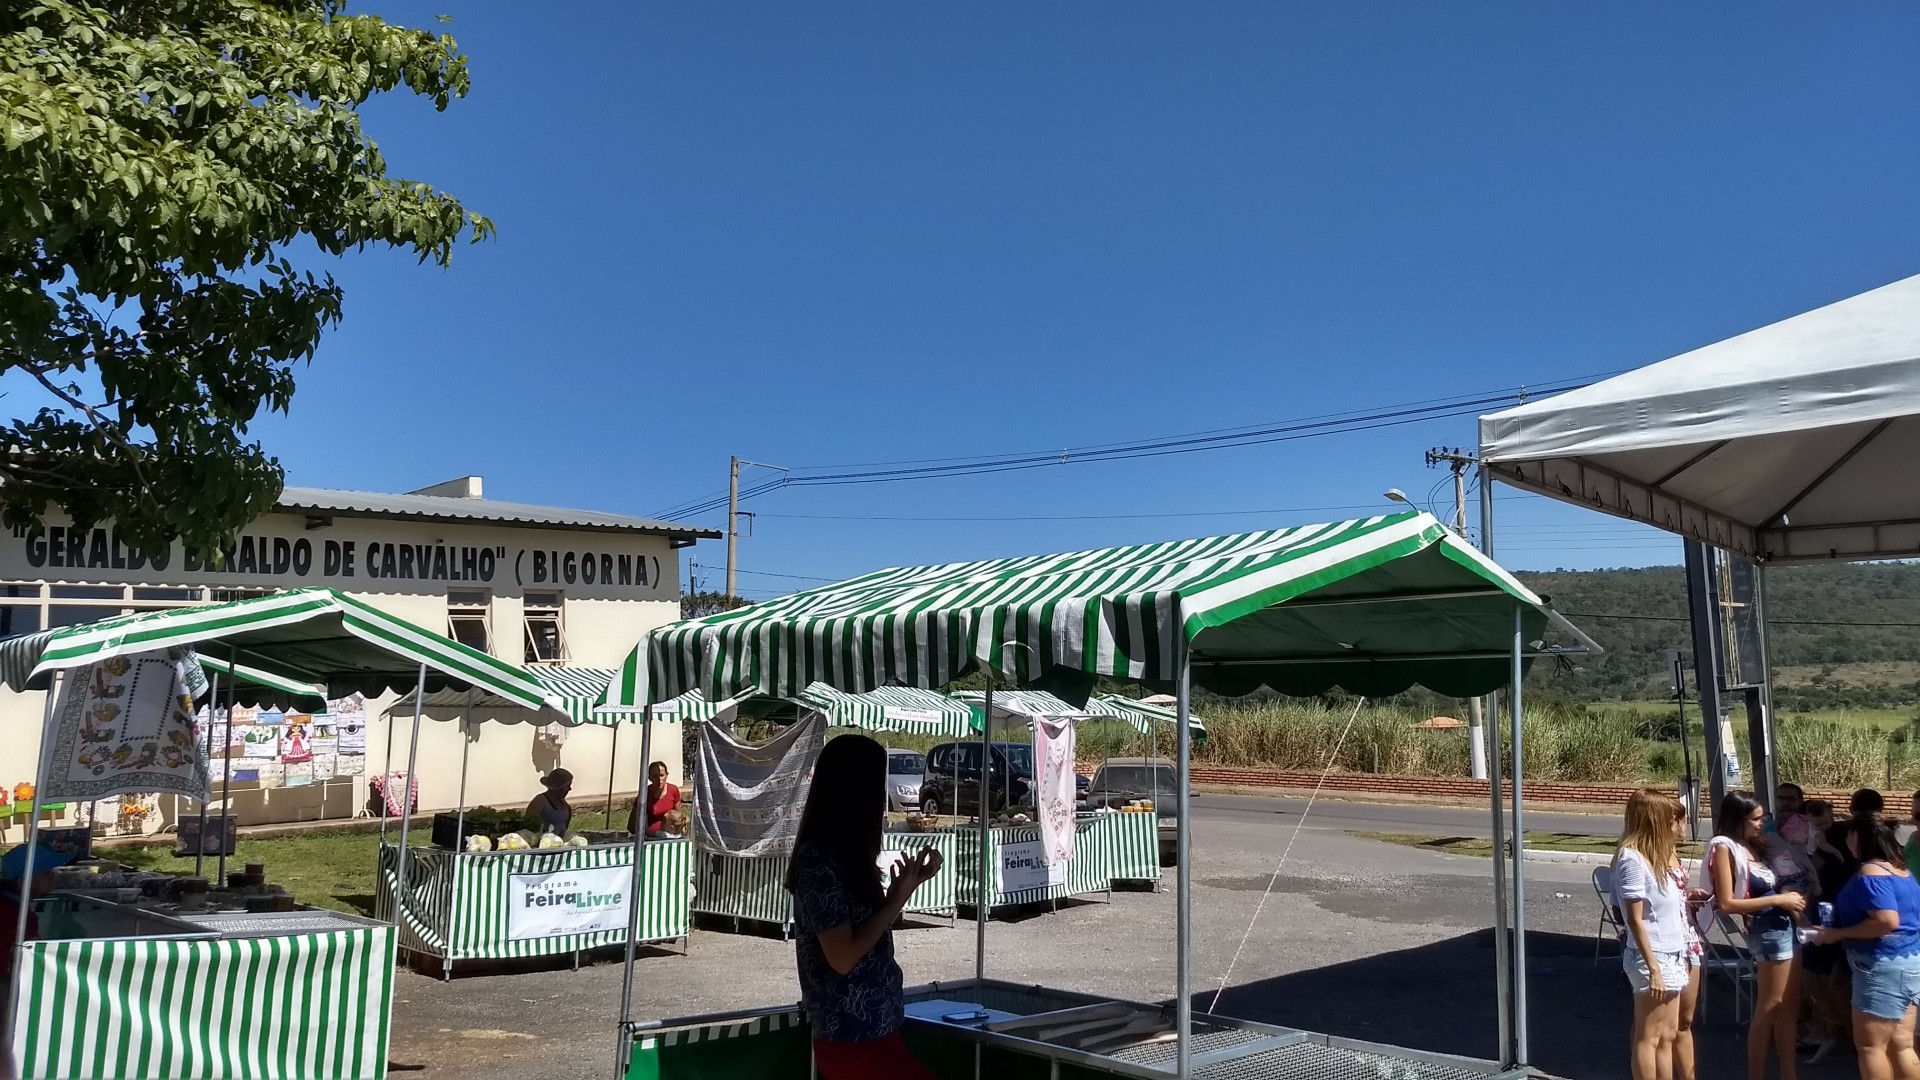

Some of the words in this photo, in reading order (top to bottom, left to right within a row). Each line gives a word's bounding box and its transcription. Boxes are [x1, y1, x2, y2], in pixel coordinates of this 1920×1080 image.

[184, 533, 312, 576] BRALDO
[323, 540, 354, 577] DE
[366, 541, 506, 583] CARVALHO"
[525, 880, 578, 890] Programa
